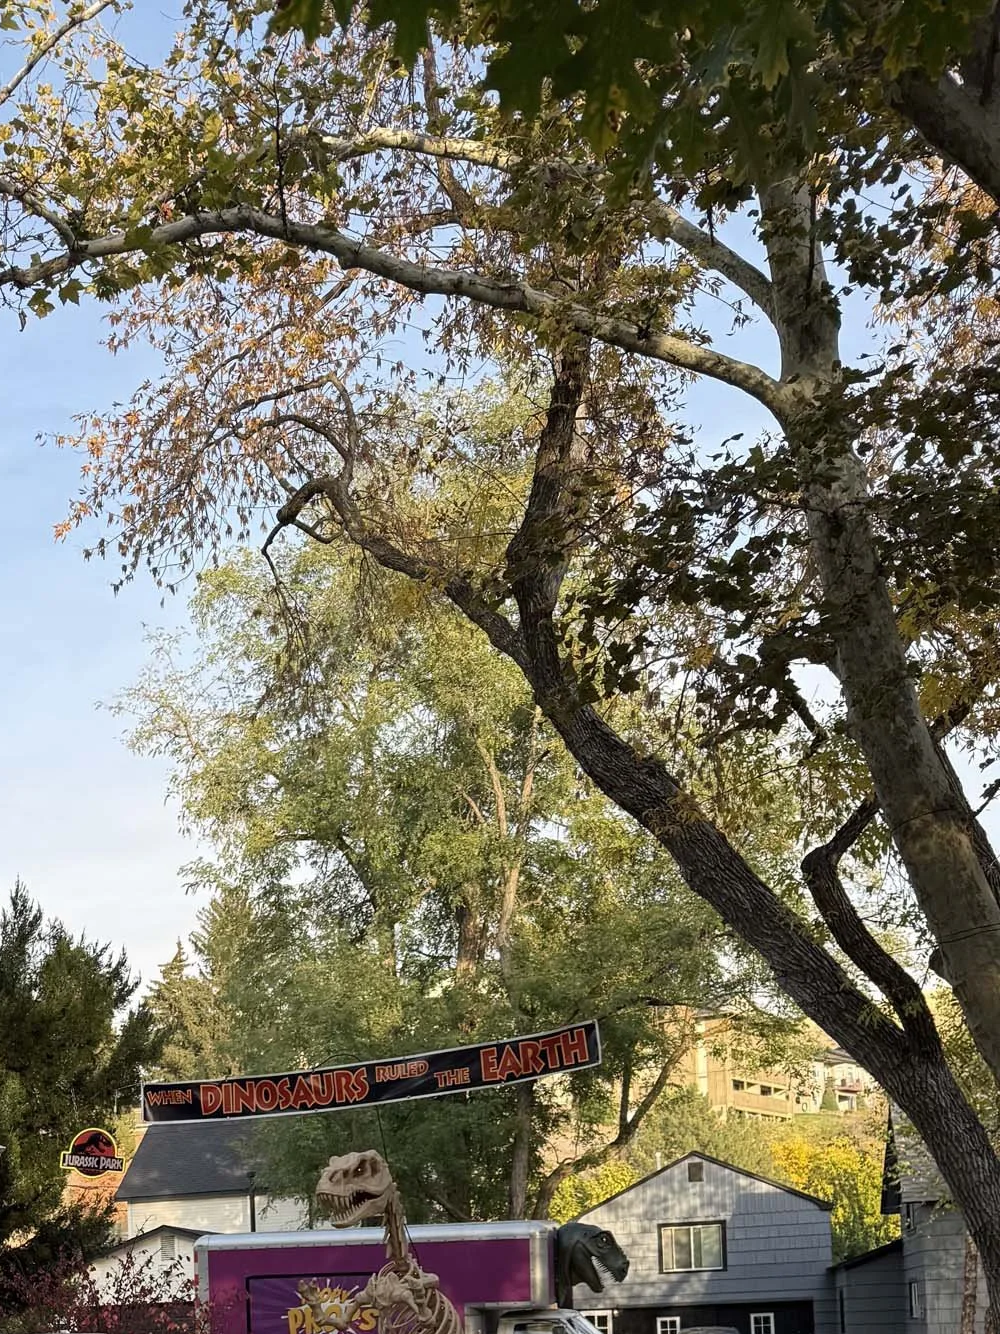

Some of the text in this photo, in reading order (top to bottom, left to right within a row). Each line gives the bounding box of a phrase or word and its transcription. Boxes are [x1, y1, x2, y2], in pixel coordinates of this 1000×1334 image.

[147, 1028, 589, 1115] WHEN DINOSAURS RULED THE EARTH
[63, 1154, 122, 1170] JURASSIC PARK
